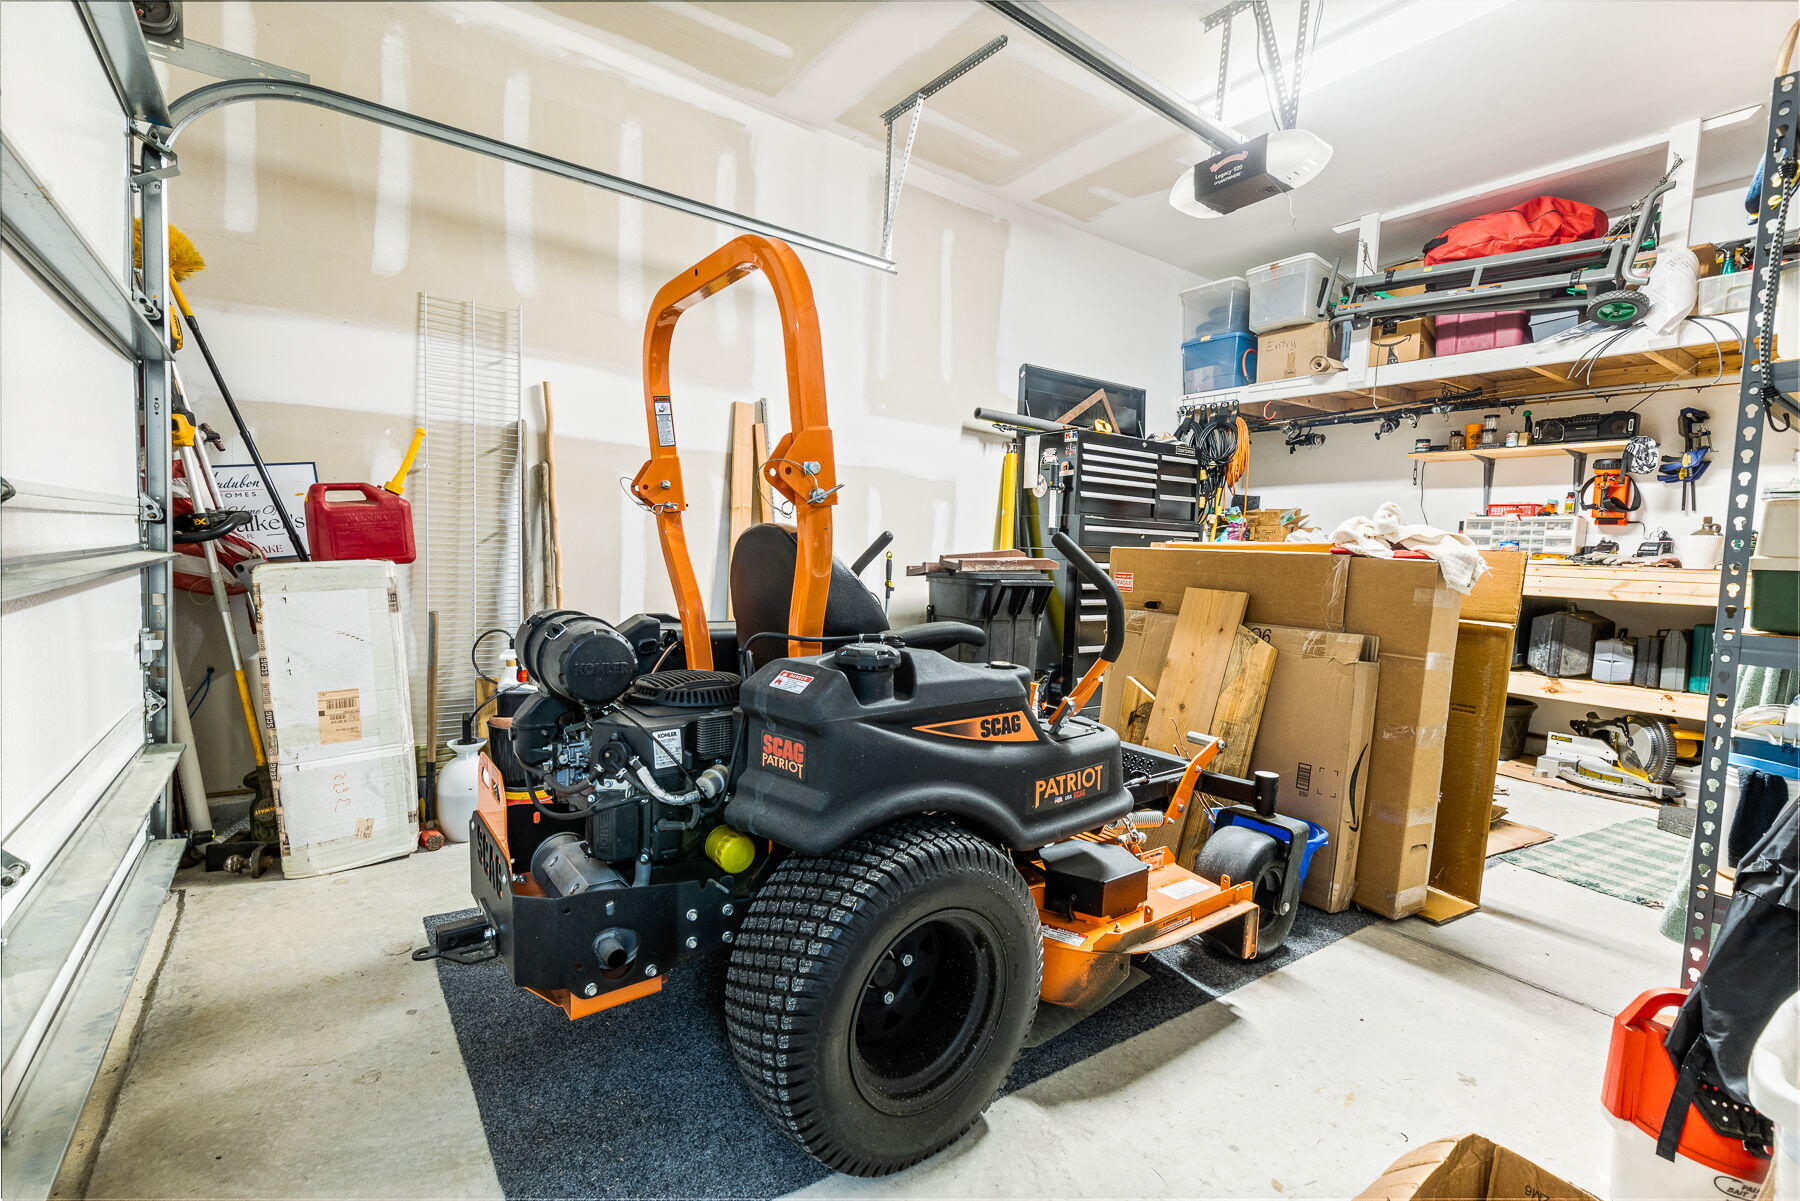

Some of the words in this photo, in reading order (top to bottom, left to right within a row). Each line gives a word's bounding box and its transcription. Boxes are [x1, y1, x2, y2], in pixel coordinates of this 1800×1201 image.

[1265, 337, 1297, 352] Entry
[214, 472, 261, 489] udubon
[237, 514, 305, 532] alke's
[262, 545, 284, 554] AKE
[260, 657, 269, 677] SCAG
[266, 711, 275, 729] SCAG
[980, 714, 1021, 739] SCAG
[657, 731, 678, 739] KOHLER
[763, 733, 805, 764] SCAG
[270, 762, 278, 780] SCAG
[762, 752, 804, 779] PATRIOT
[1033, 764, 1104, 809] PATRIOT
[477, 824, 502, 901] SCAG
[1727, 1187, 1749, 1197] BAIT
